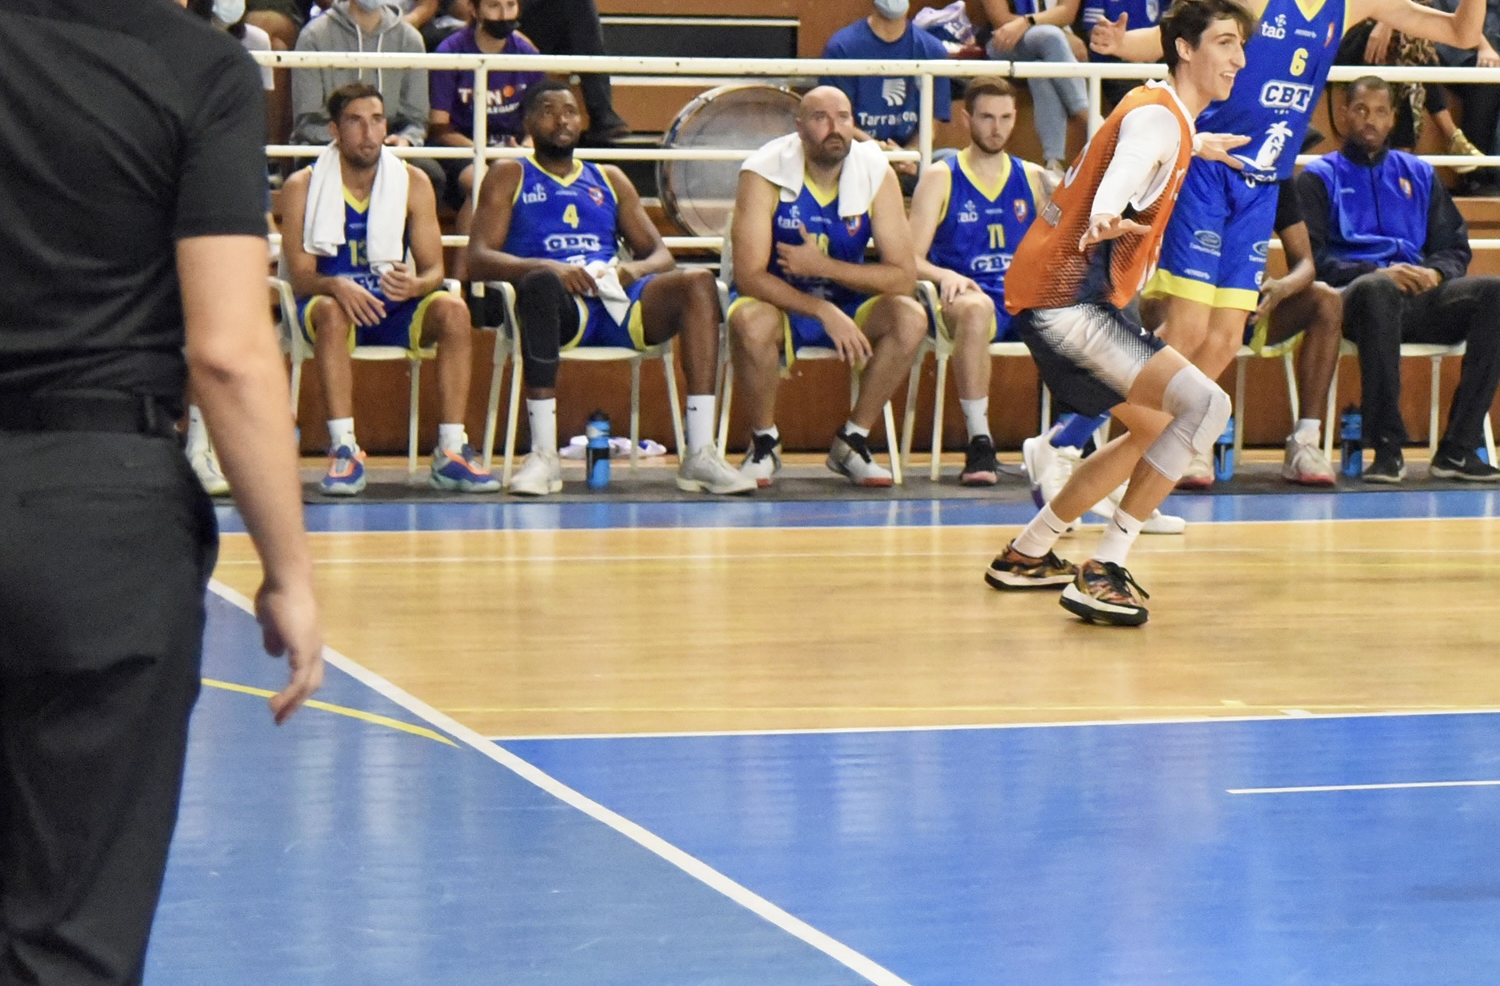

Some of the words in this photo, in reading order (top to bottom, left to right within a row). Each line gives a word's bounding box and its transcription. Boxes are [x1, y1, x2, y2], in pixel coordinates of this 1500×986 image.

[1290, 47, 1309, 77] 6
[1262, 84, 1312, 109] CBT
[563, 203, 579, 229] 4
[987, 224, 1006, 249] 11
